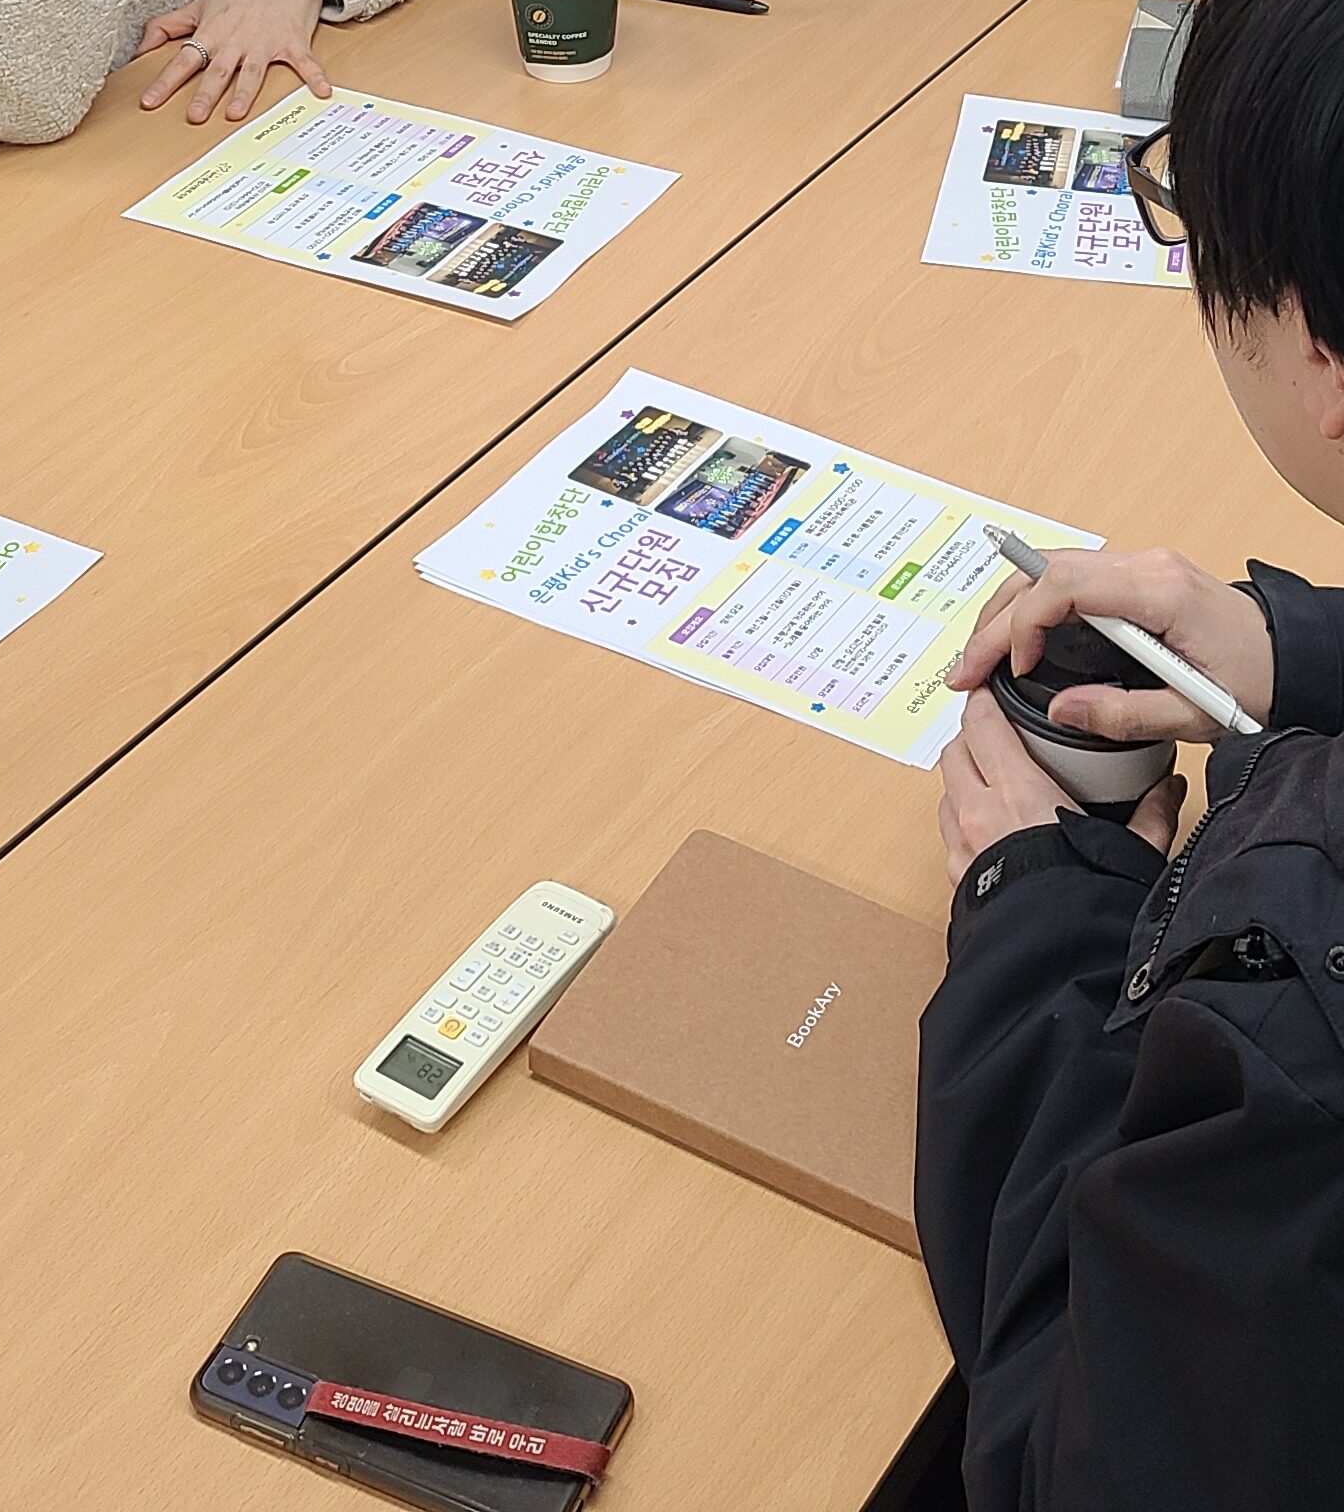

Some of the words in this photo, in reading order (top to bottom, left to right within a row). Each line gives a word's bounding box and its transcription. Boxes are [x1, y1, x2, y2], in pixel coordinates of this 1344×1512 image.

[528, 32, 560, 40] SPECIALTY
[562, 31, 588, 40] COFFEE
[528, 38, 558, 46] BLENDED
[450, 157, 500, 187] 모집
[465, 150, 545, 206] 신규단원
[530, 154, 585, 191] 은평Kid's
[489, 192, 534, 221] Choral
[542, 166, 609, 233] 어린이합창단
[990, 187, 1020, 260] 어린이합창단
[1049, 190, 1074, 222] Choral
[1074, 202, 1112, 267] 신규단원
[1113, 218, 1146, 252] 모집
[500, 487, 590, 581] 어린이합창단
[529, 549, 601, 603] 은평Kid's
[597, 507, 652, 547] Choral
[579, 528, 680, 613] 신규단원
[637, 557, 700, 605] 모집
[540, 900, 584, 925] SAMSUNG
[786, 981, 842, 1049] BookAry
[330, 1392, 381, 1416] 생명을
[468, 1424, 506, 1446] 바로
[508, 1433, 546, 1454] 우리
